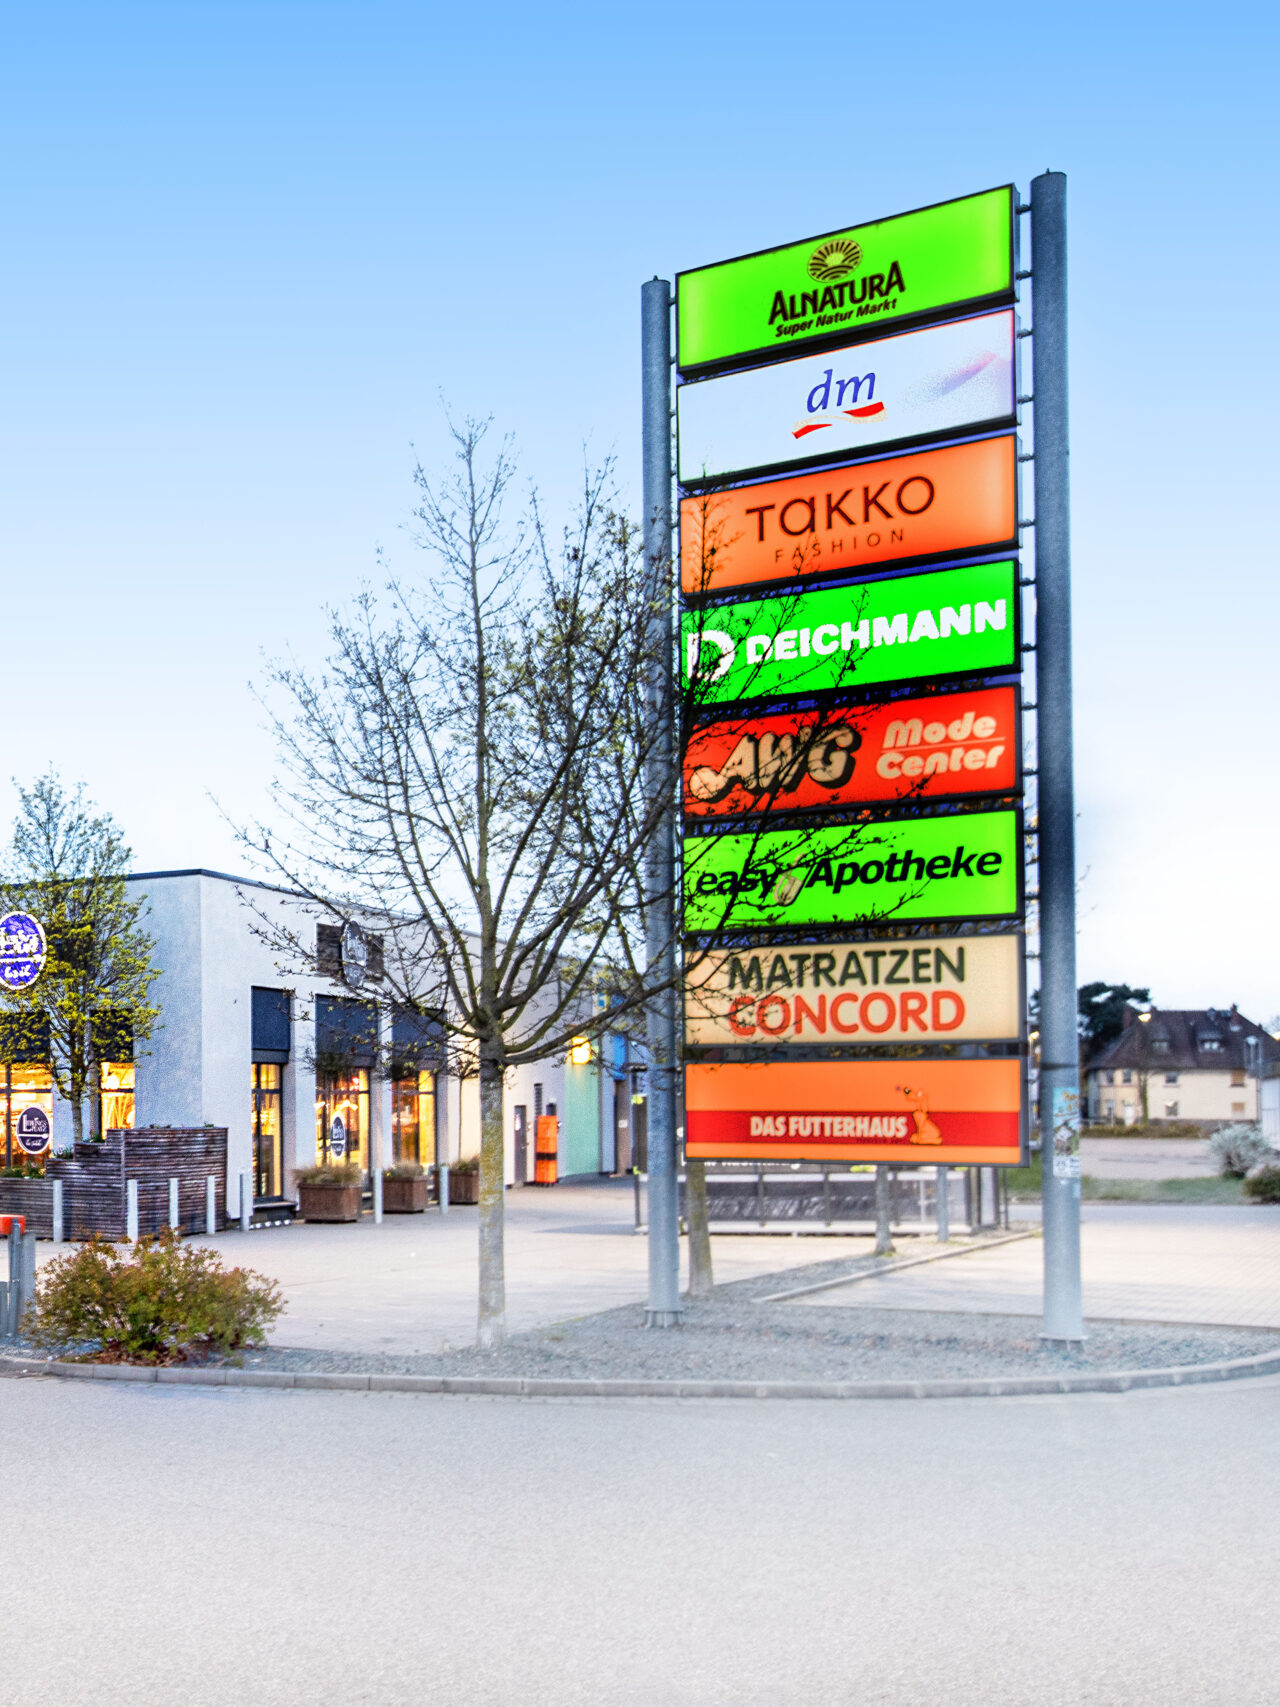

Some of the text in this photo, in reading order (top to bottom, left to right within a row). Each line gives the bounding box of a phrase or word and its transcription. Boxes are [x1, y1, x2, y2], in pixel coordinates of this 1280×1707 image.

[768, 260, 906, 325] ALNATURA
[775, 298, 898, 338] Super Natur Markt
[807, 368, 876, 413] dm
[775, 528, 905, 563] FASHION
[746, 598, 1007, 665] DEICHMANN
[882, 711, 997, 747] Mode
[688, 725, 861, 803] AWG
[875, 744, 1006, 780] Center
[696, 846, 1002, 899] easy Apotheke
[727, 946, 967, 991] MATRATZEN
[727, 989, 967, 1036] CONCORD
[750, 1115, 908, 1139] DAS FUTTERHAUS
